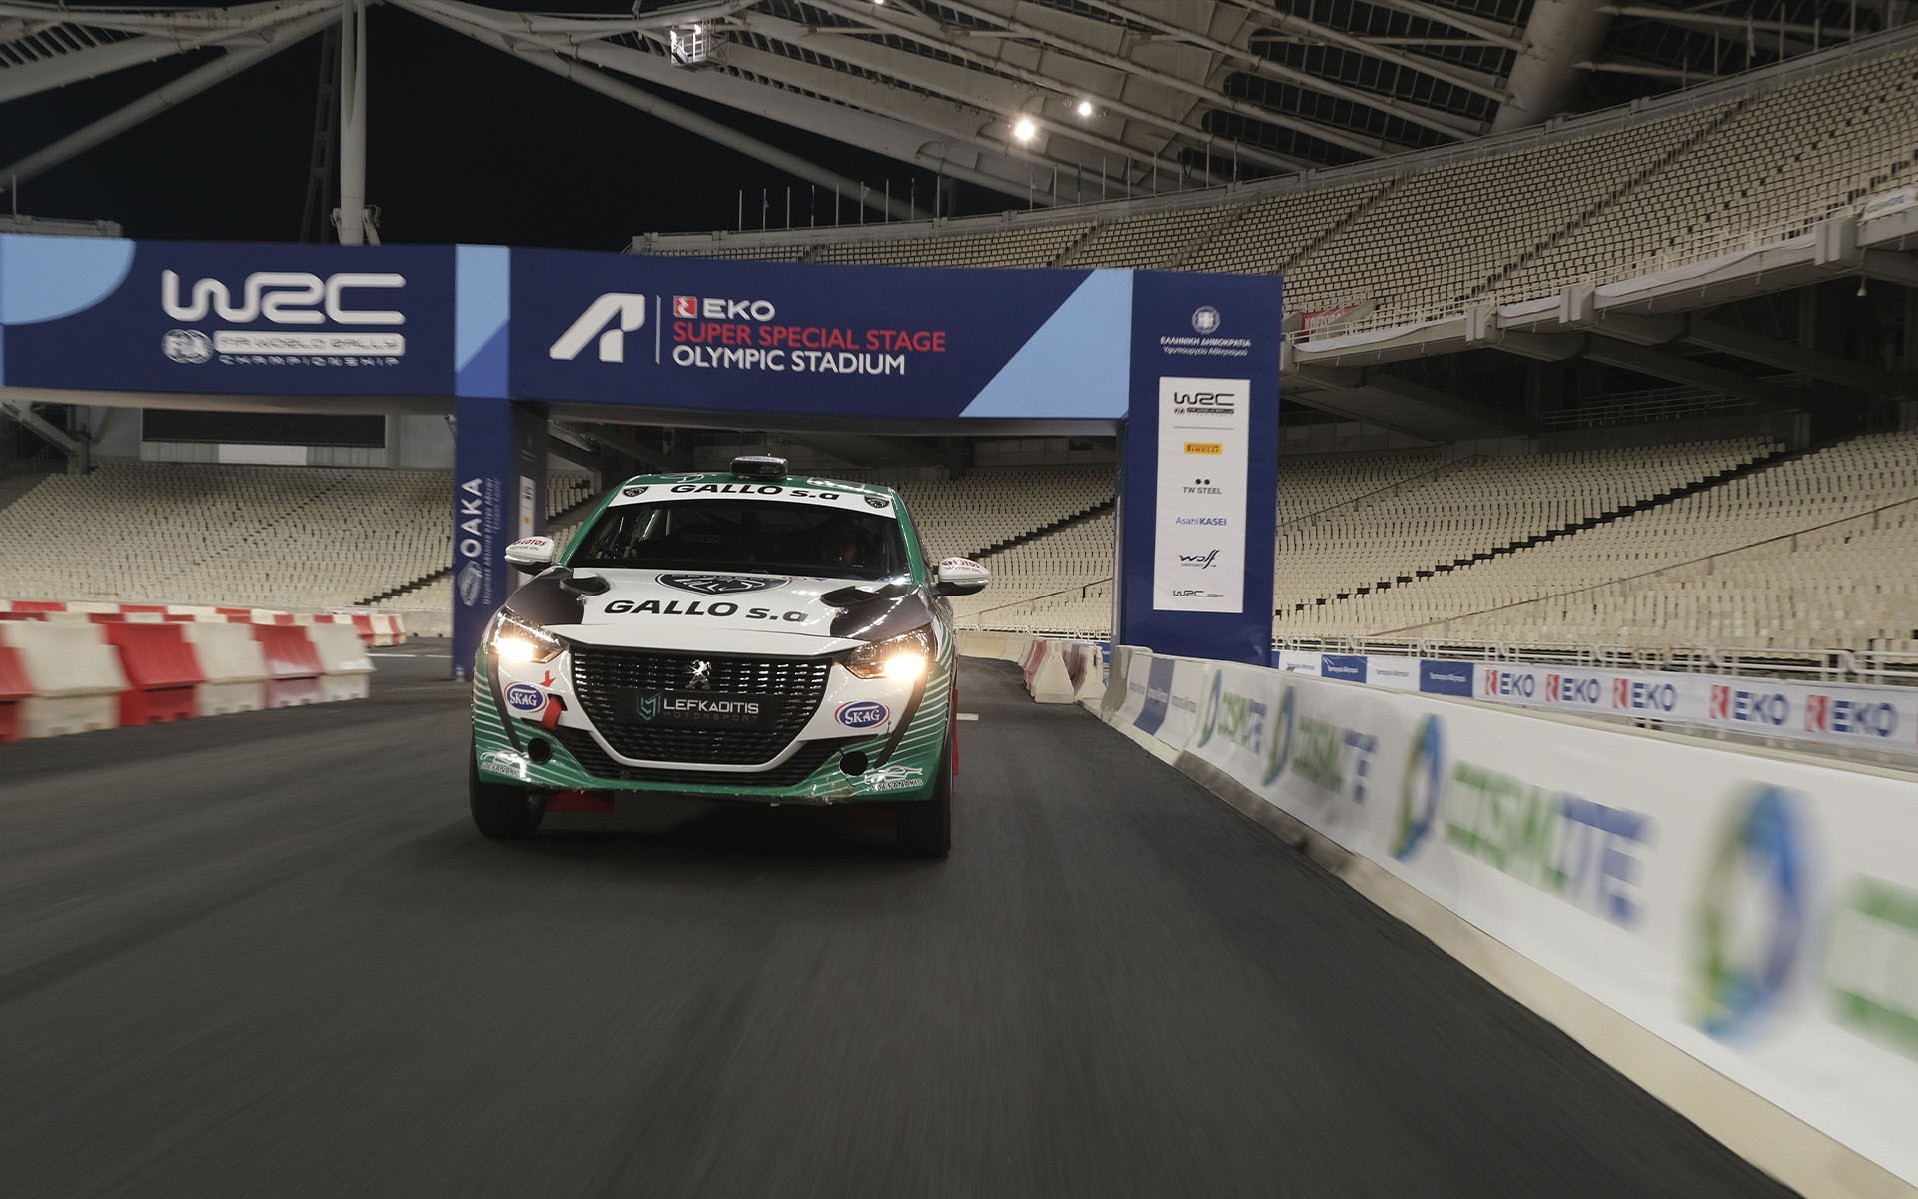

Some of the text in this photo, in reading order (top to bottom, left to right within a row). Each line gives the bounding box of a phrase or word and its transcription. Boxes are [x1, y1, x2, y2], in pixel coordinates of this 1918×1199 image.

[162, 269, 406, 325] WRC
[701, 298, 776, 321] EKO
[672, 321, 947, 353] SUPER SPECIAL STAGE
[672, 346, 906, 376] OLYMPIC STADIUM
[1174, 392, 1235, 406] WRC
[670, 484, 783, 495] GALLO
[1182, 486, 1222, 495] TW STEEL
[604, 600, 739, 617] GALLO
[509, 687, 538, 707] SKAG
[1500, 672, 1535, 698] EKO
[1562, 677, 1601, 704] EKO
[1631, 682, 1678, 712] EKO
[663, 698, 759, 714] LEFKADITIS
[844, 704, 881, 725] SKAG
[1733, 690, 1791, 726] EKO
[1831, 700, 1899, 738] EKO
